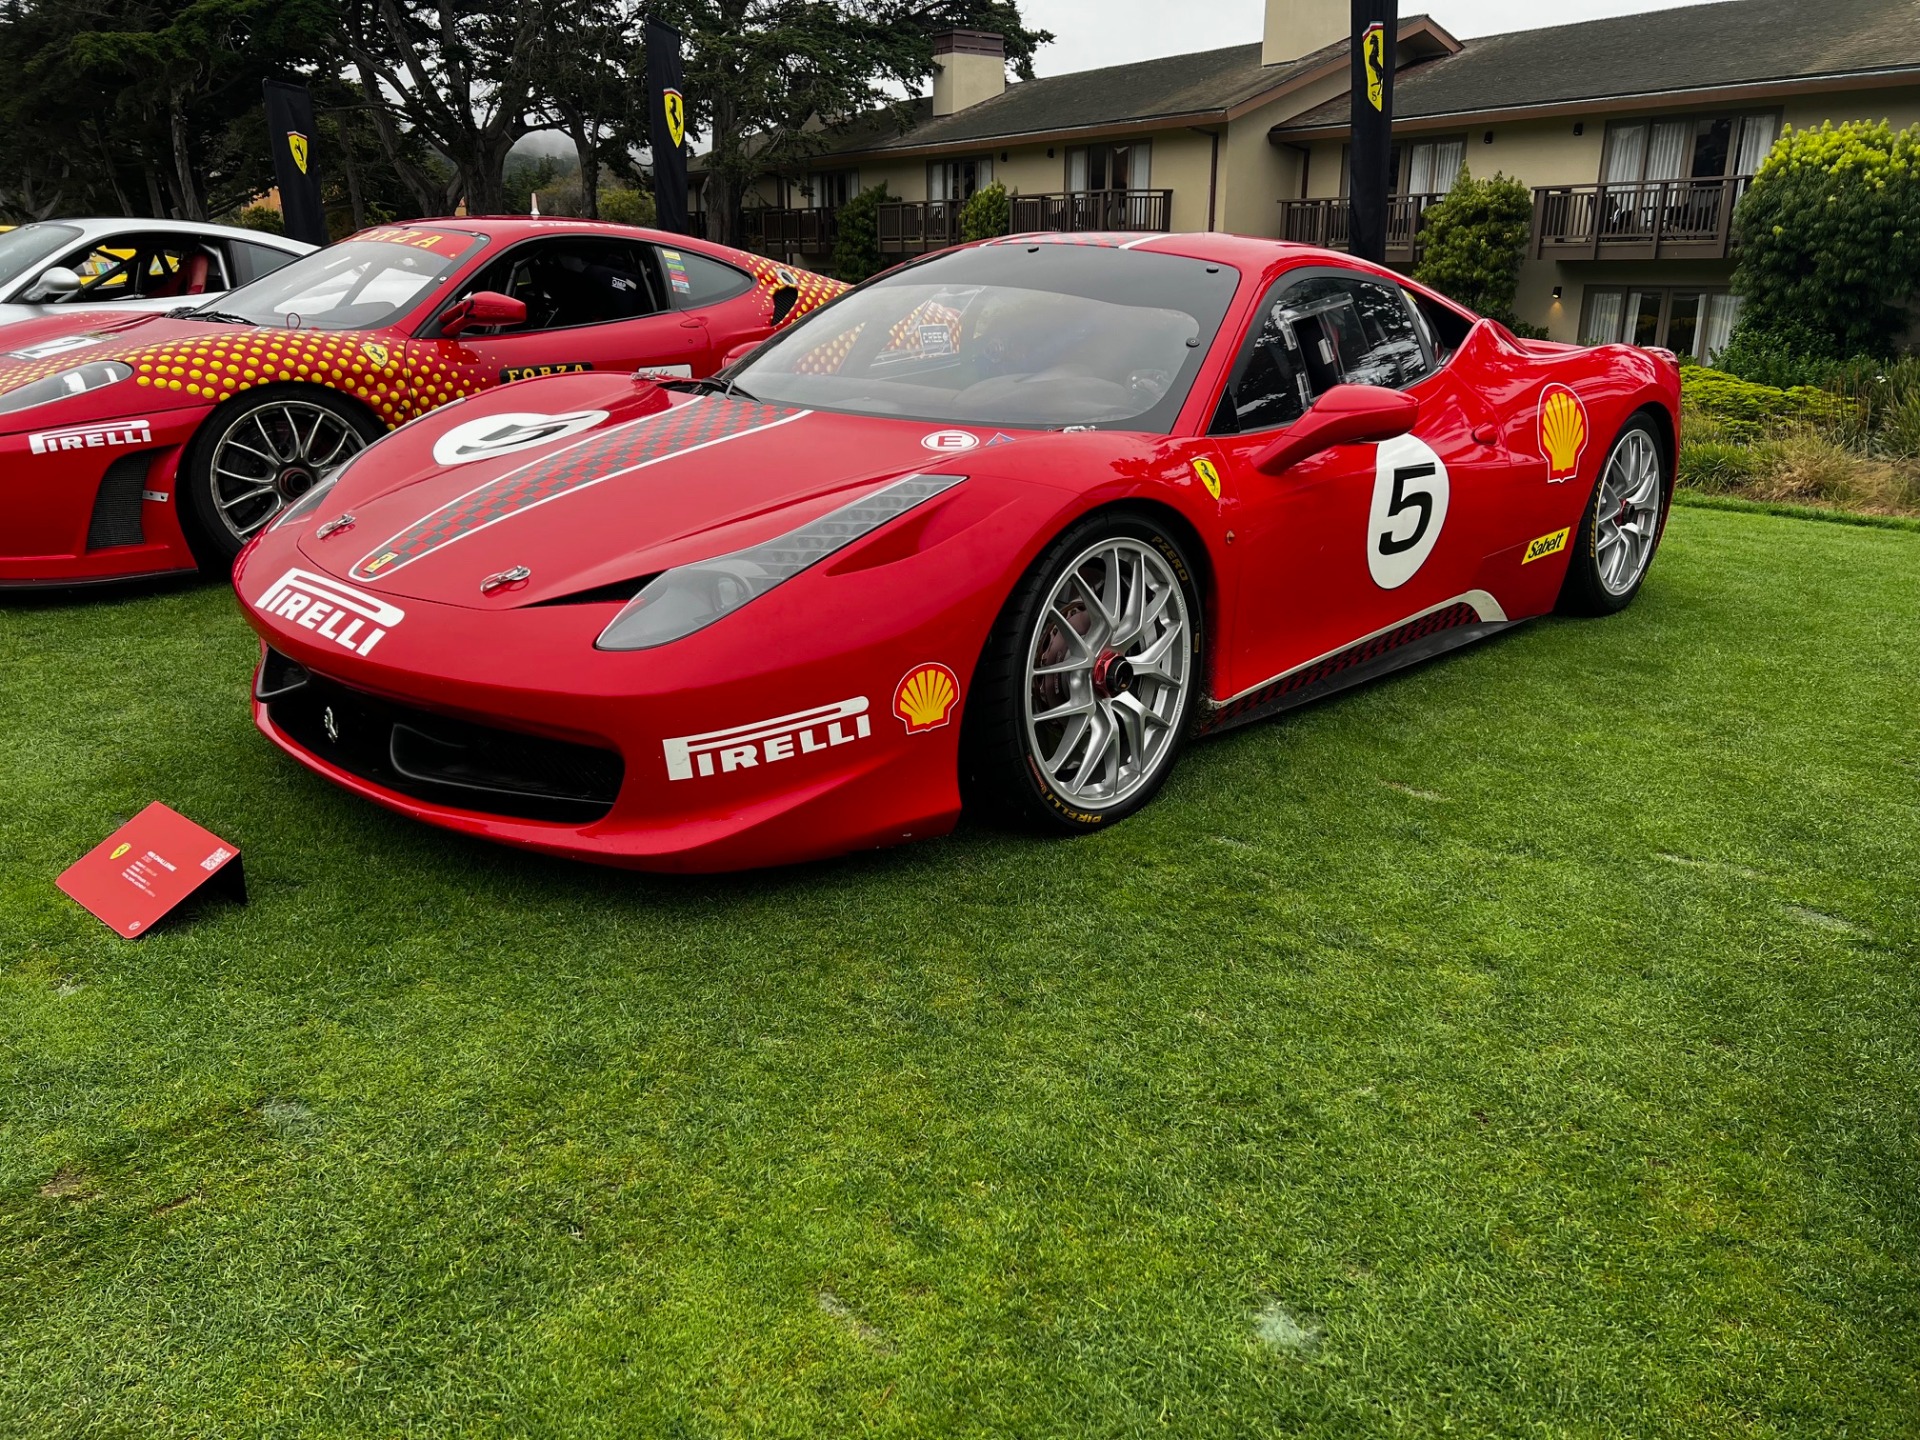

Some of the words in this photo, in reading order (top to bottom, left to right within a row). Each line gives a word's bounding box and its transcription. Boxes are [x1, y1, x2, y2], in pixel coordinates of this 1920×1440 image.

[353, 230, 443, 248] ORZA
[612, 278, 626, 290] OMP
[28, 420, 152, 454] PIRELLI
[456, 414, 593, 455] 5
[937, 436, 962, 447] E
[1378, 462, 1436, 555] 5
[1528, 531, 1565, 559] Sabelt
[254, 567, 405, 657] PIRELLI
[662, 696, 871, 781] PIRELLI
[1047, 793, 1103, 823] PIRELLI
